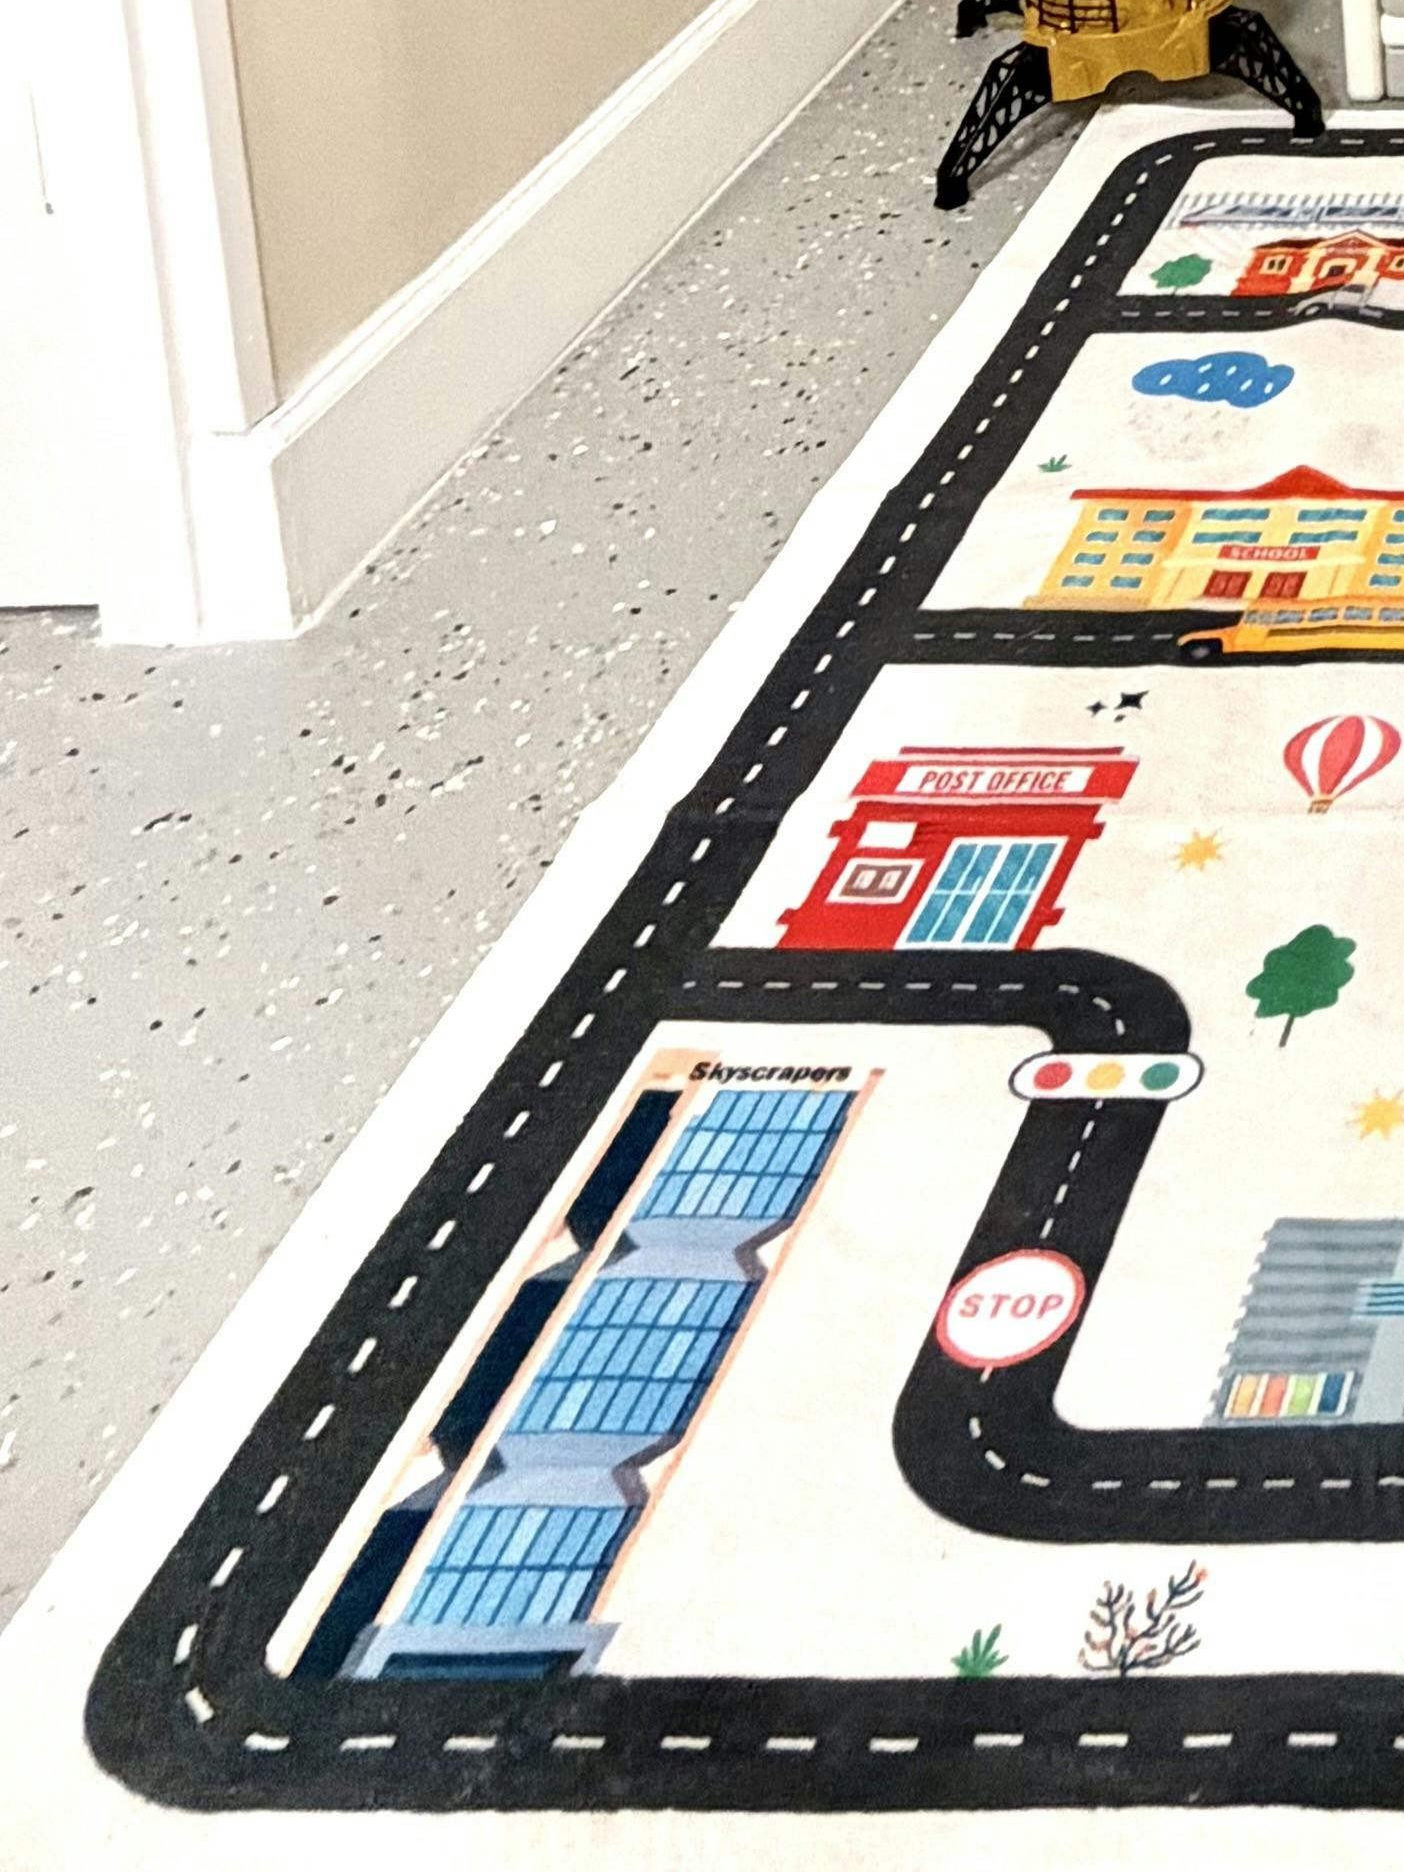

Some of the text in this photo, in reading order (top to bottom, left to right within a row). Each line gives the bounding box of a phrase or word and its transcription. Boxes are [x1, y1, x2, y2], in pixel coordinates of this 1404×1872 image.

[1229, 546, 1310, 559] SCHOOL
[917, 768, 1071, 794] POST OFFICE
[687, 1060, 852, 1088] Skyscrapers
[958, 1292, 1067, 1322] STOP
